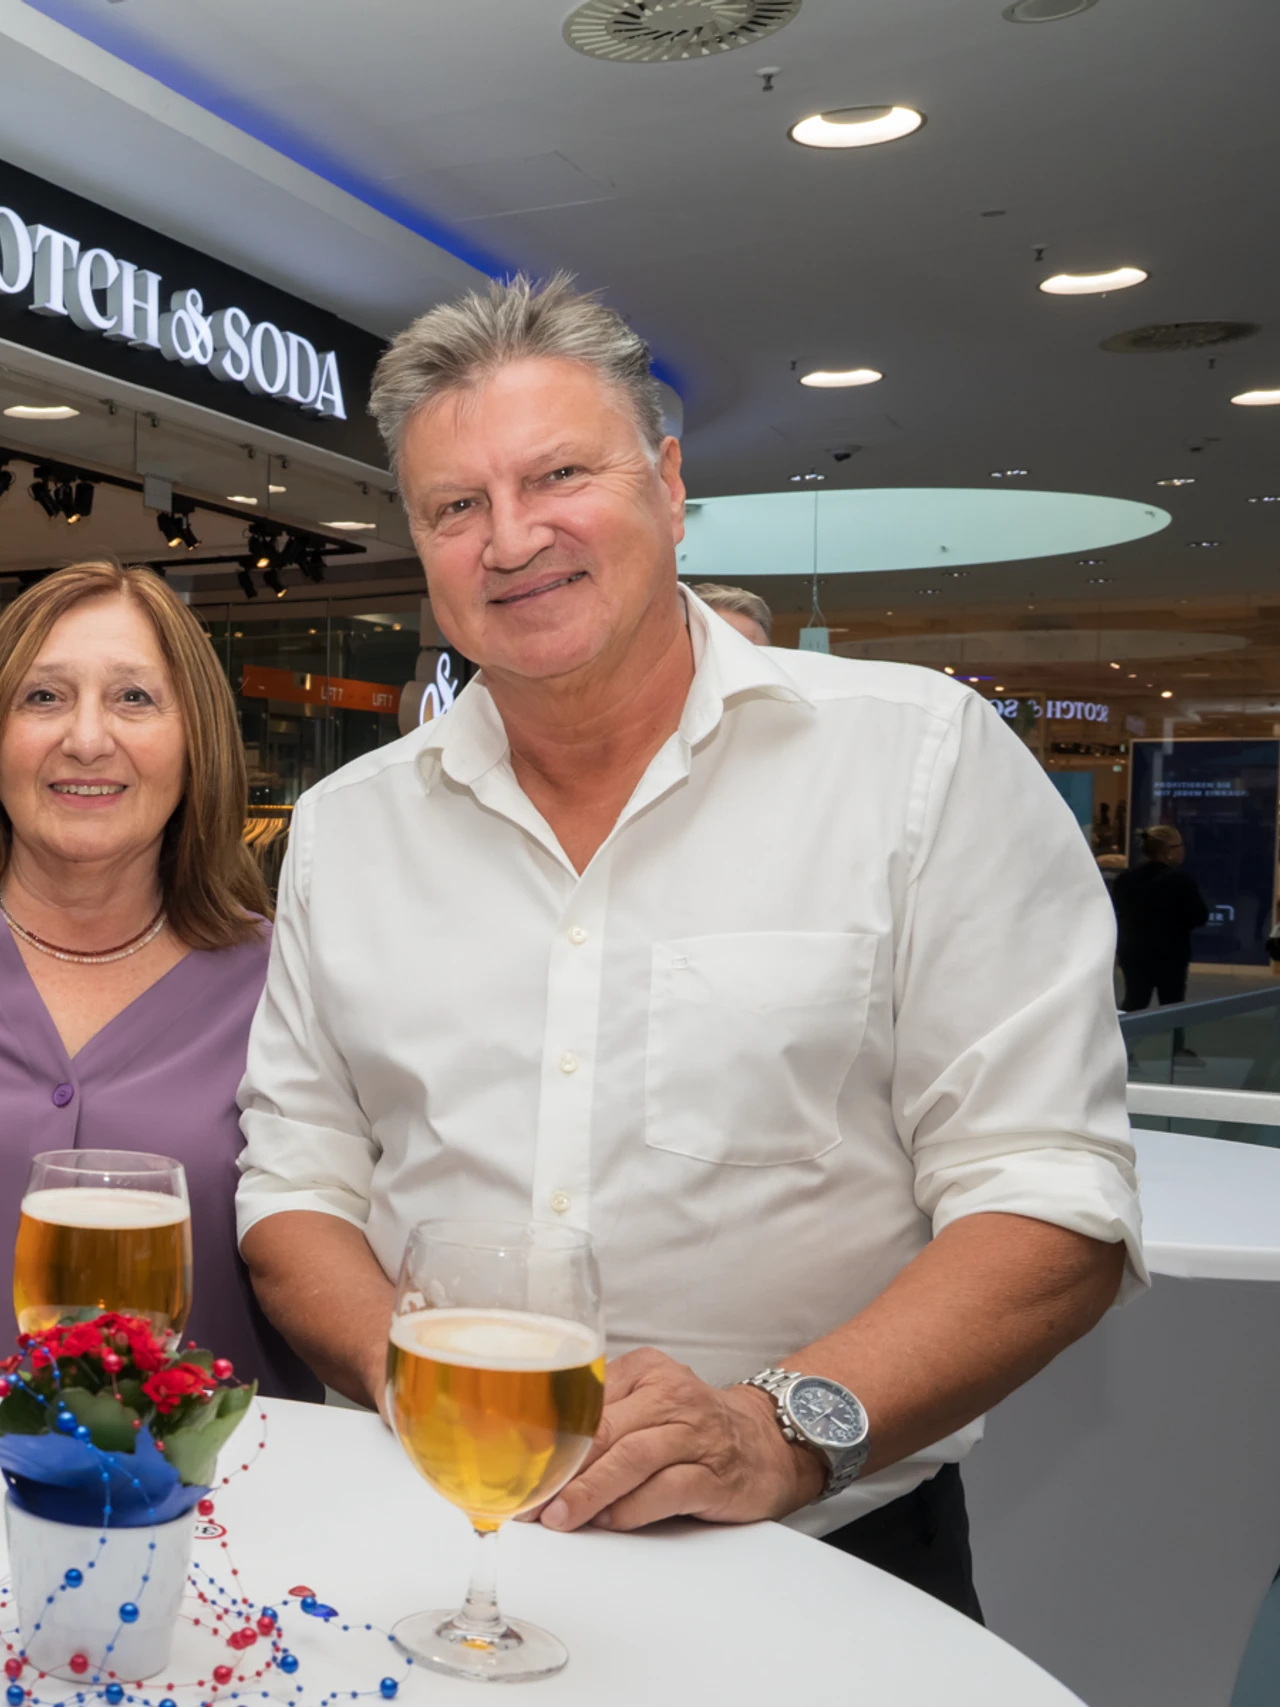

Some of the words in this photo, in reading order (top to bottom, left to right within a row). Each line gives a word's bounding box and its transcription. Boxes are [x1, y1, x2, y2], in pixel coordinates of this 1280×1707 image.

[160, 288, 214, 367] &
[208, 306, 348, 421] SODA
[320, 685, 337, 701] LFT
